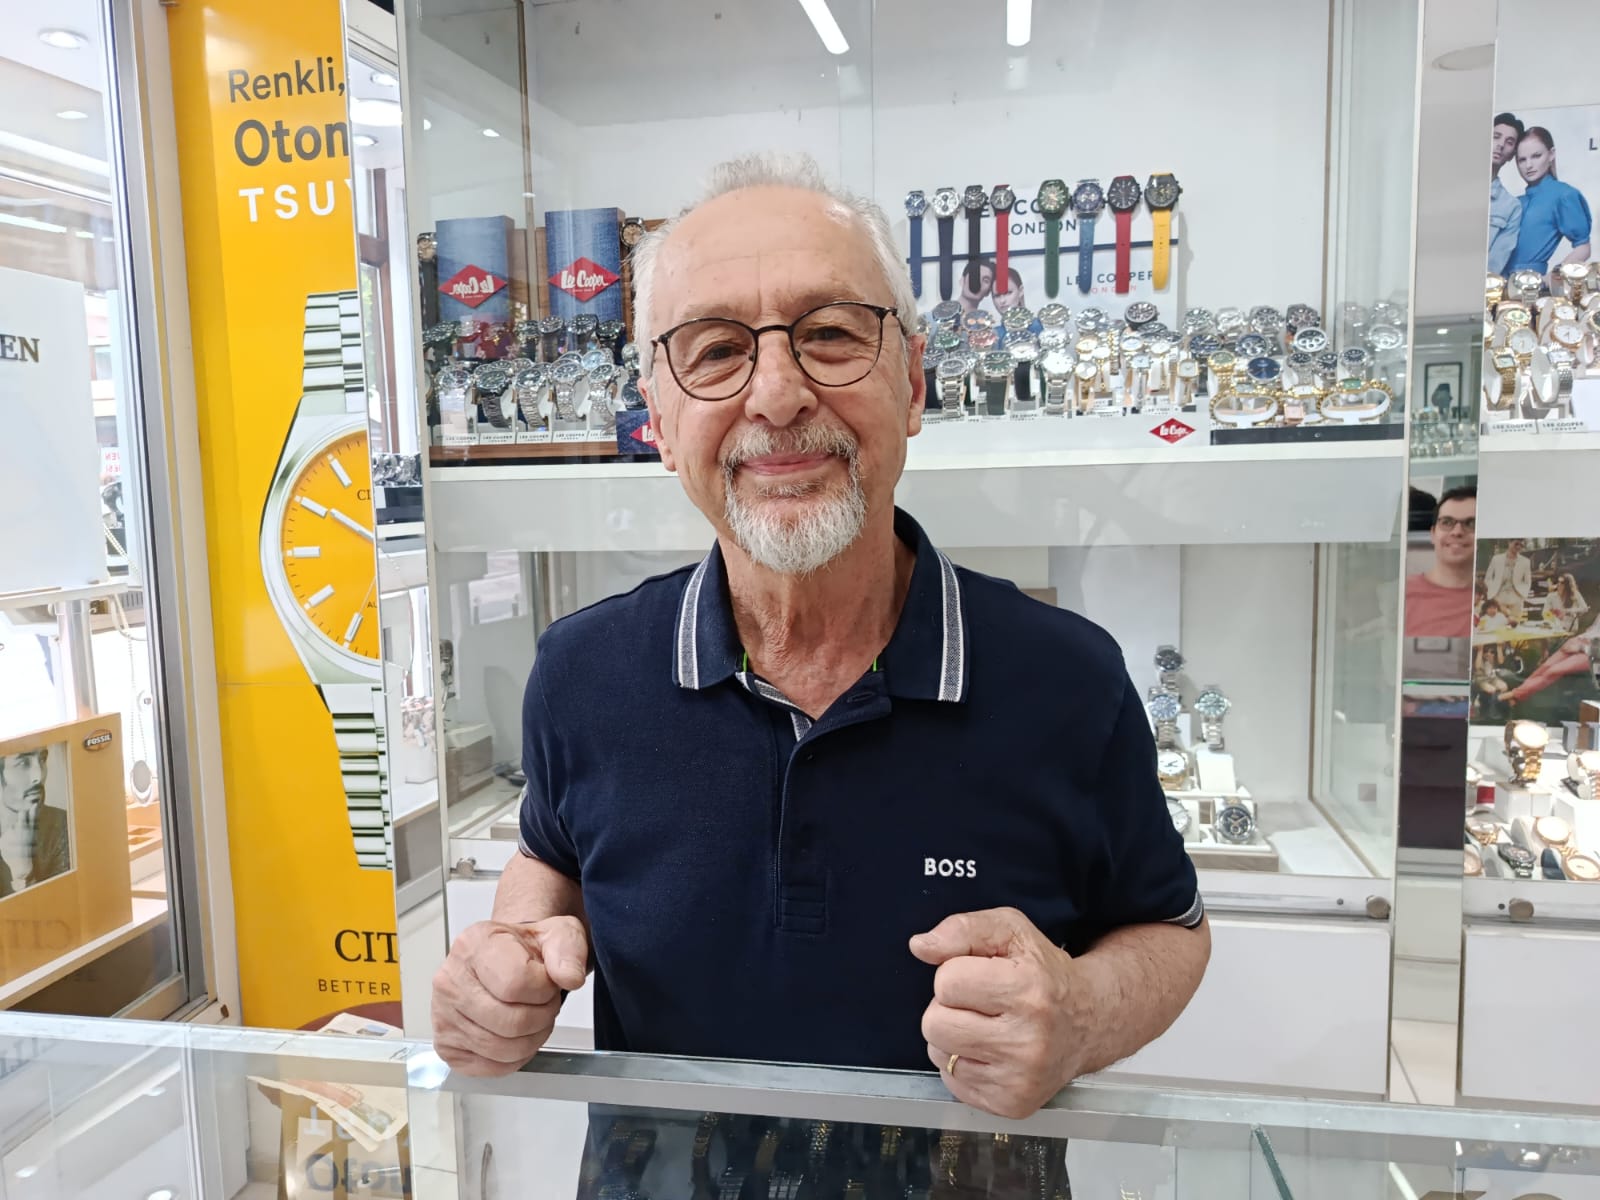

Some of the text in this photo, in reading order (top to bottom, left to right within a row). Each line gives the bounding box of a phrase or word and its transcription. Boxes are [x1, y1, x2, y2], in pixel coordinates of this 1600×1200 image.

[228, 56, 345, 103] Renkli,
[924, 857, 977, 878] BOSS
[334, 929, 398, 963] CIT
[318, 979, 391, 995] BETTER
